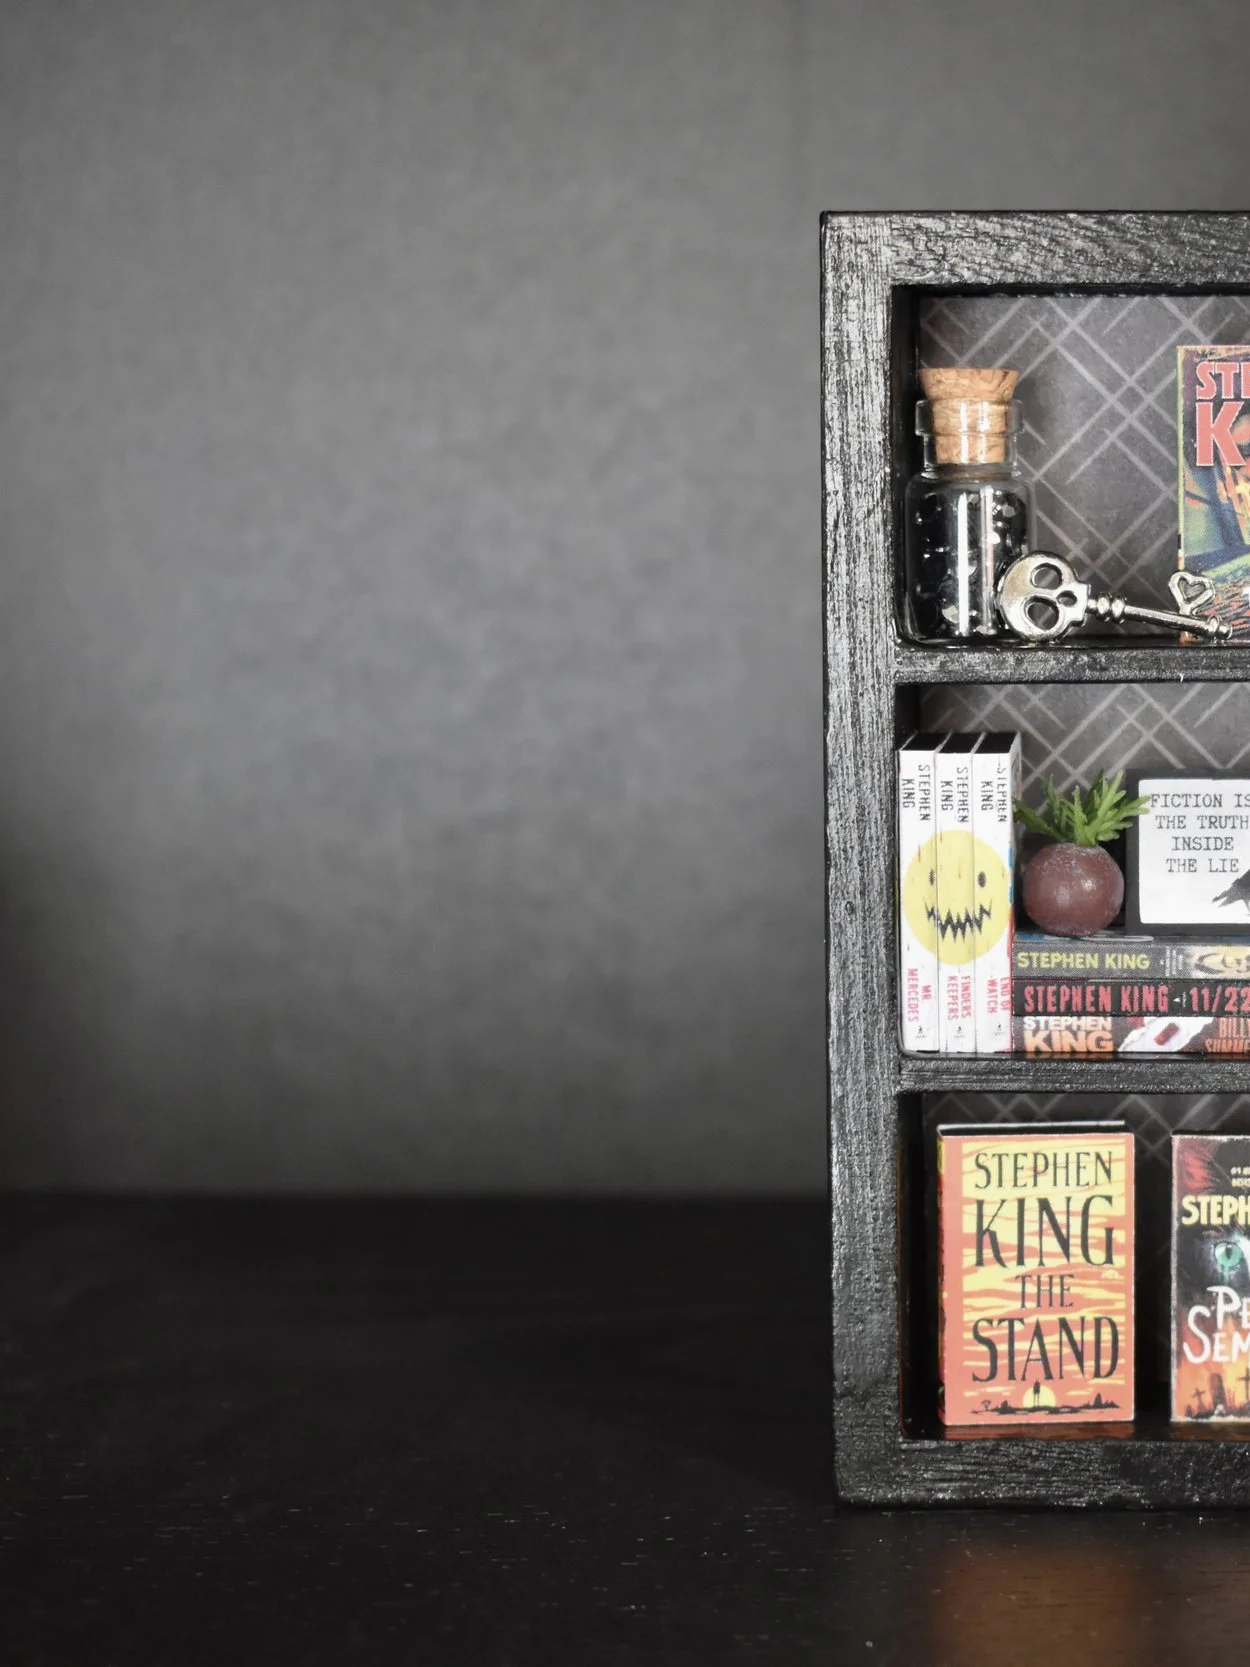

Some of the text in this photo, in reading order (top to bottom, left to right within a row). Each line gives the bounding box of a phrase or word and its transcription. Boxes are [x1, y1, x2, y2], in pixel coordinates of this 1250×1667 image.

[902, 778, 916, 809] KING
[918, 764, 931, 821] STEPHEN
[940, 780, 954, 811] KING
[957, 767, 969, 823] STEPHEN
[980, 780, 994, 811] KING
[996, 767, 1008, 823] STEPHEN
[1150, 793, 1223, 808] FICTION
[1154, 815, 1250, 829] THE TRUTH
[1171, 836, 1234, 851] INSIDE
[1165, 858, 1240, 873] THE LIE
[1017, 951, 1099, 969] STEPHEN
[1104, 952, 1151, 970] KING
[907, 968, 919, 1022] MERCEDES
[922, 985, 932, 1001] MR
[947, 975, 959, 1021] KEEPERS
[961, 975, 972, 1019] FINDERS
[986, 979, 998, 1014] WATCH
[1024, 985, 1112, 1013] STEPHEN
[1120, 984, 1169, 1013] KING
[1023, 1016, 1112, 1031] STEPHEN
[1024, 1030, 1114, 1052] KING
[975, 1151, 1112, 1189] STEPHEN
[975, 1195, 1114, 1268] KING
[1015, 1274, 1074, 1308] THE
[972, 1316, 1119, 1382] STAND
